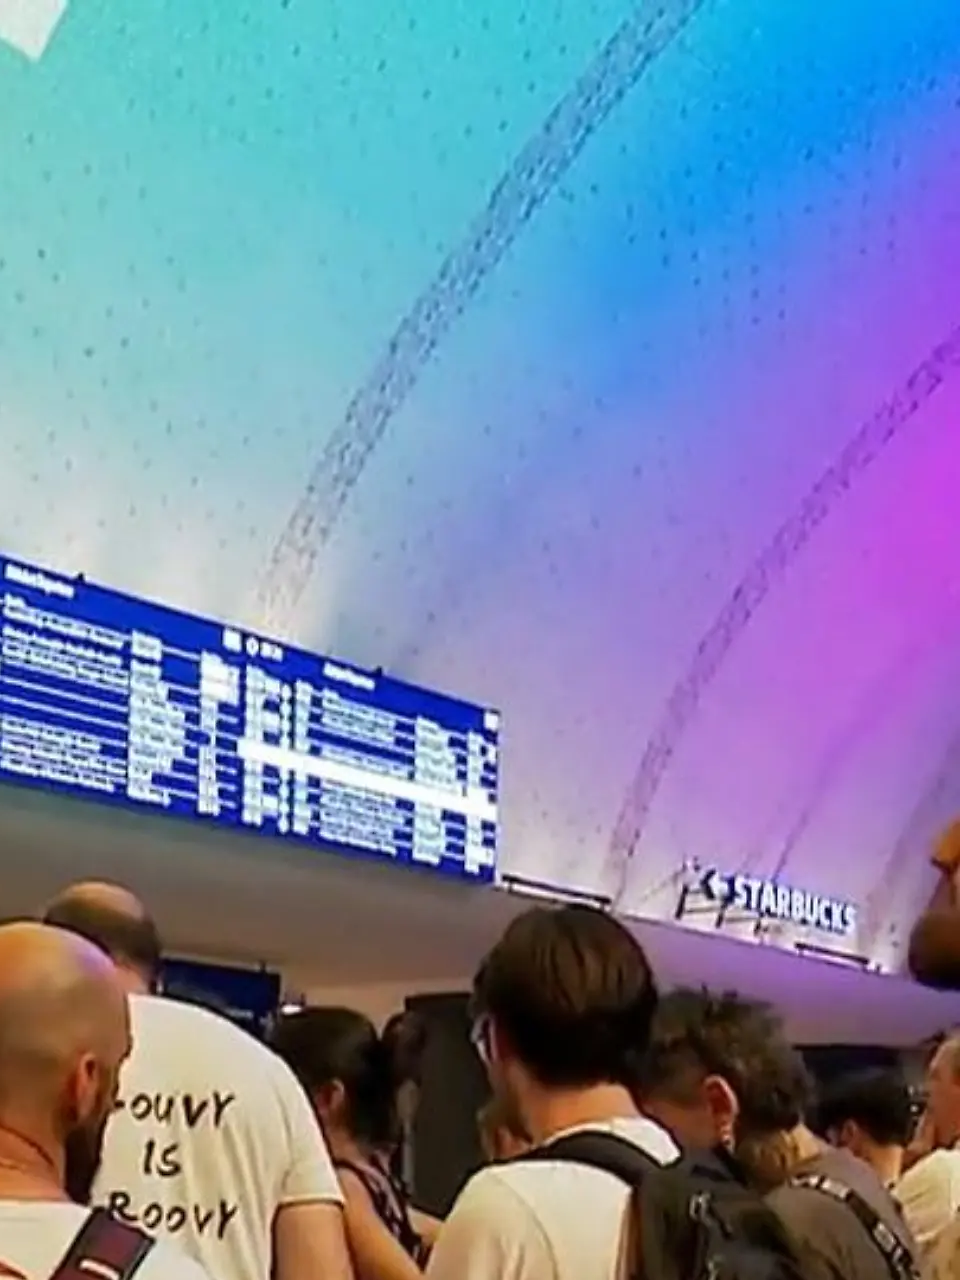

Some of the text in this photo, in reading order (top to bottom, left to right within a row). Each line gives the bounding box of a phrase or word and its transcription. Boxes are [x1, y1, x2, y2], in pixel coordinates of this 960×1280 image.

[734, 873, 857, 934] STARBUCKS
[114, 1090, 236, 1127] OUVY
[143, 1139, 182, 1177] IS
